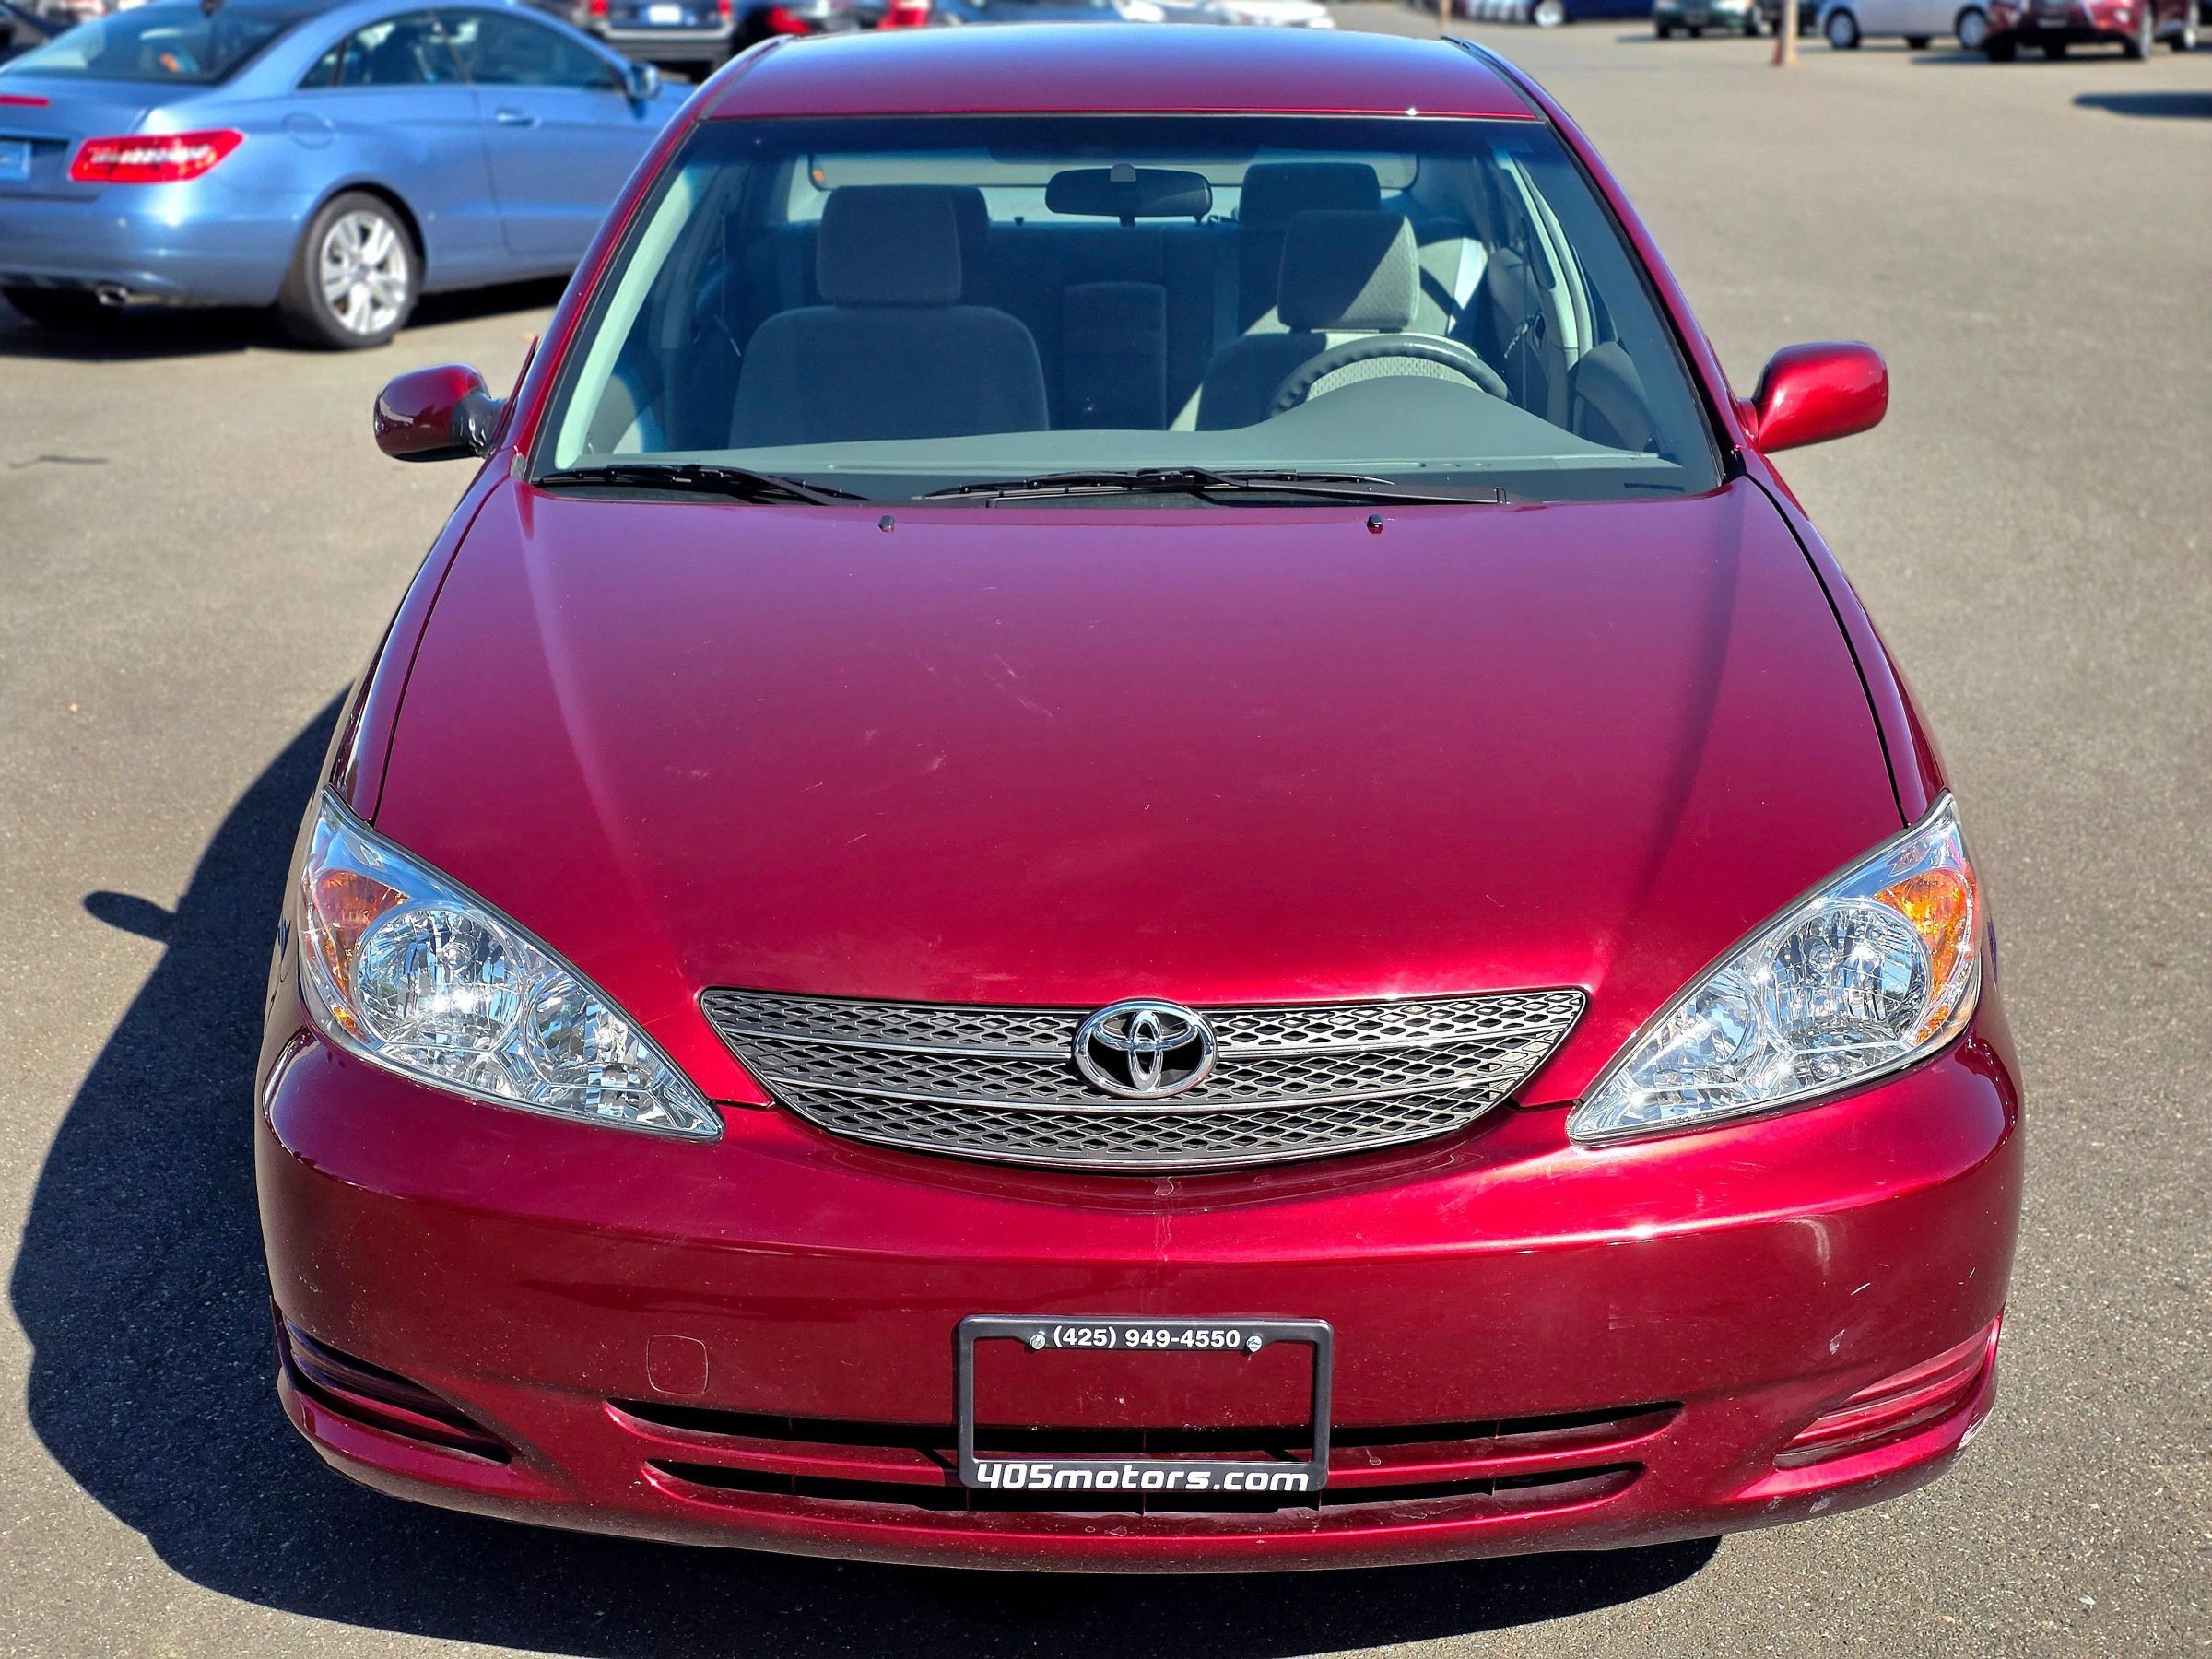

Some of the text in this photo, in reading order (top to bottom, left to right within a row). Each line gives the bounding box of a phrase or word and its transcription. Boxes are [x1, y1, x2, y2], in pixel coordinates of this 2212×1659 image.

[1053, 1326, 1240, 1348] (425) 949-4550
[977, 1463, 1308, 1491] 405motors.com
